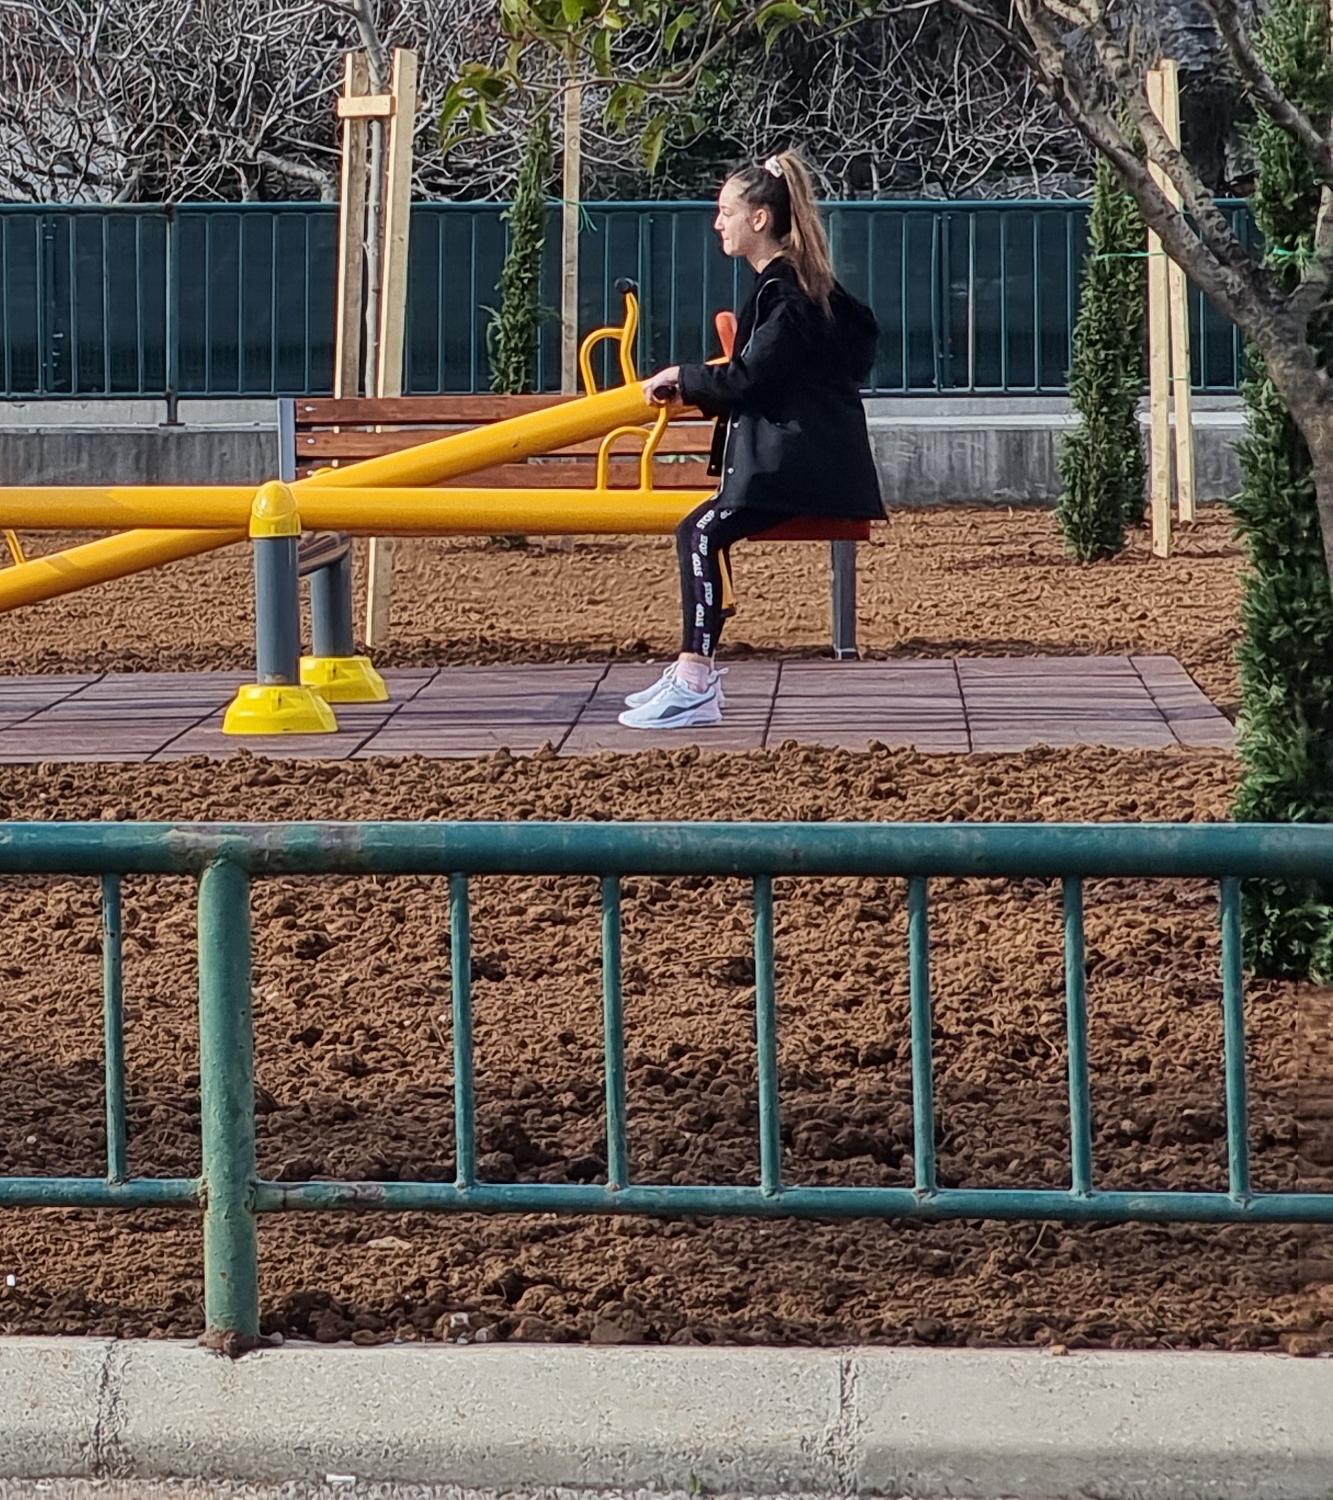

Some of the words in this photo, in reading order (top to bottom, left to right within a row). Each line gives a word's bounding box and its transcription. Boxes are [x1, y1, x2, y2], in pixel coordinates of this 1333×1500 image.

[696, 509, 715, 530] STOP
[692, 552, 704, 577] STOP
[703, 581, 713, 606] STOP
[695, 603, 705, 627] STOP
